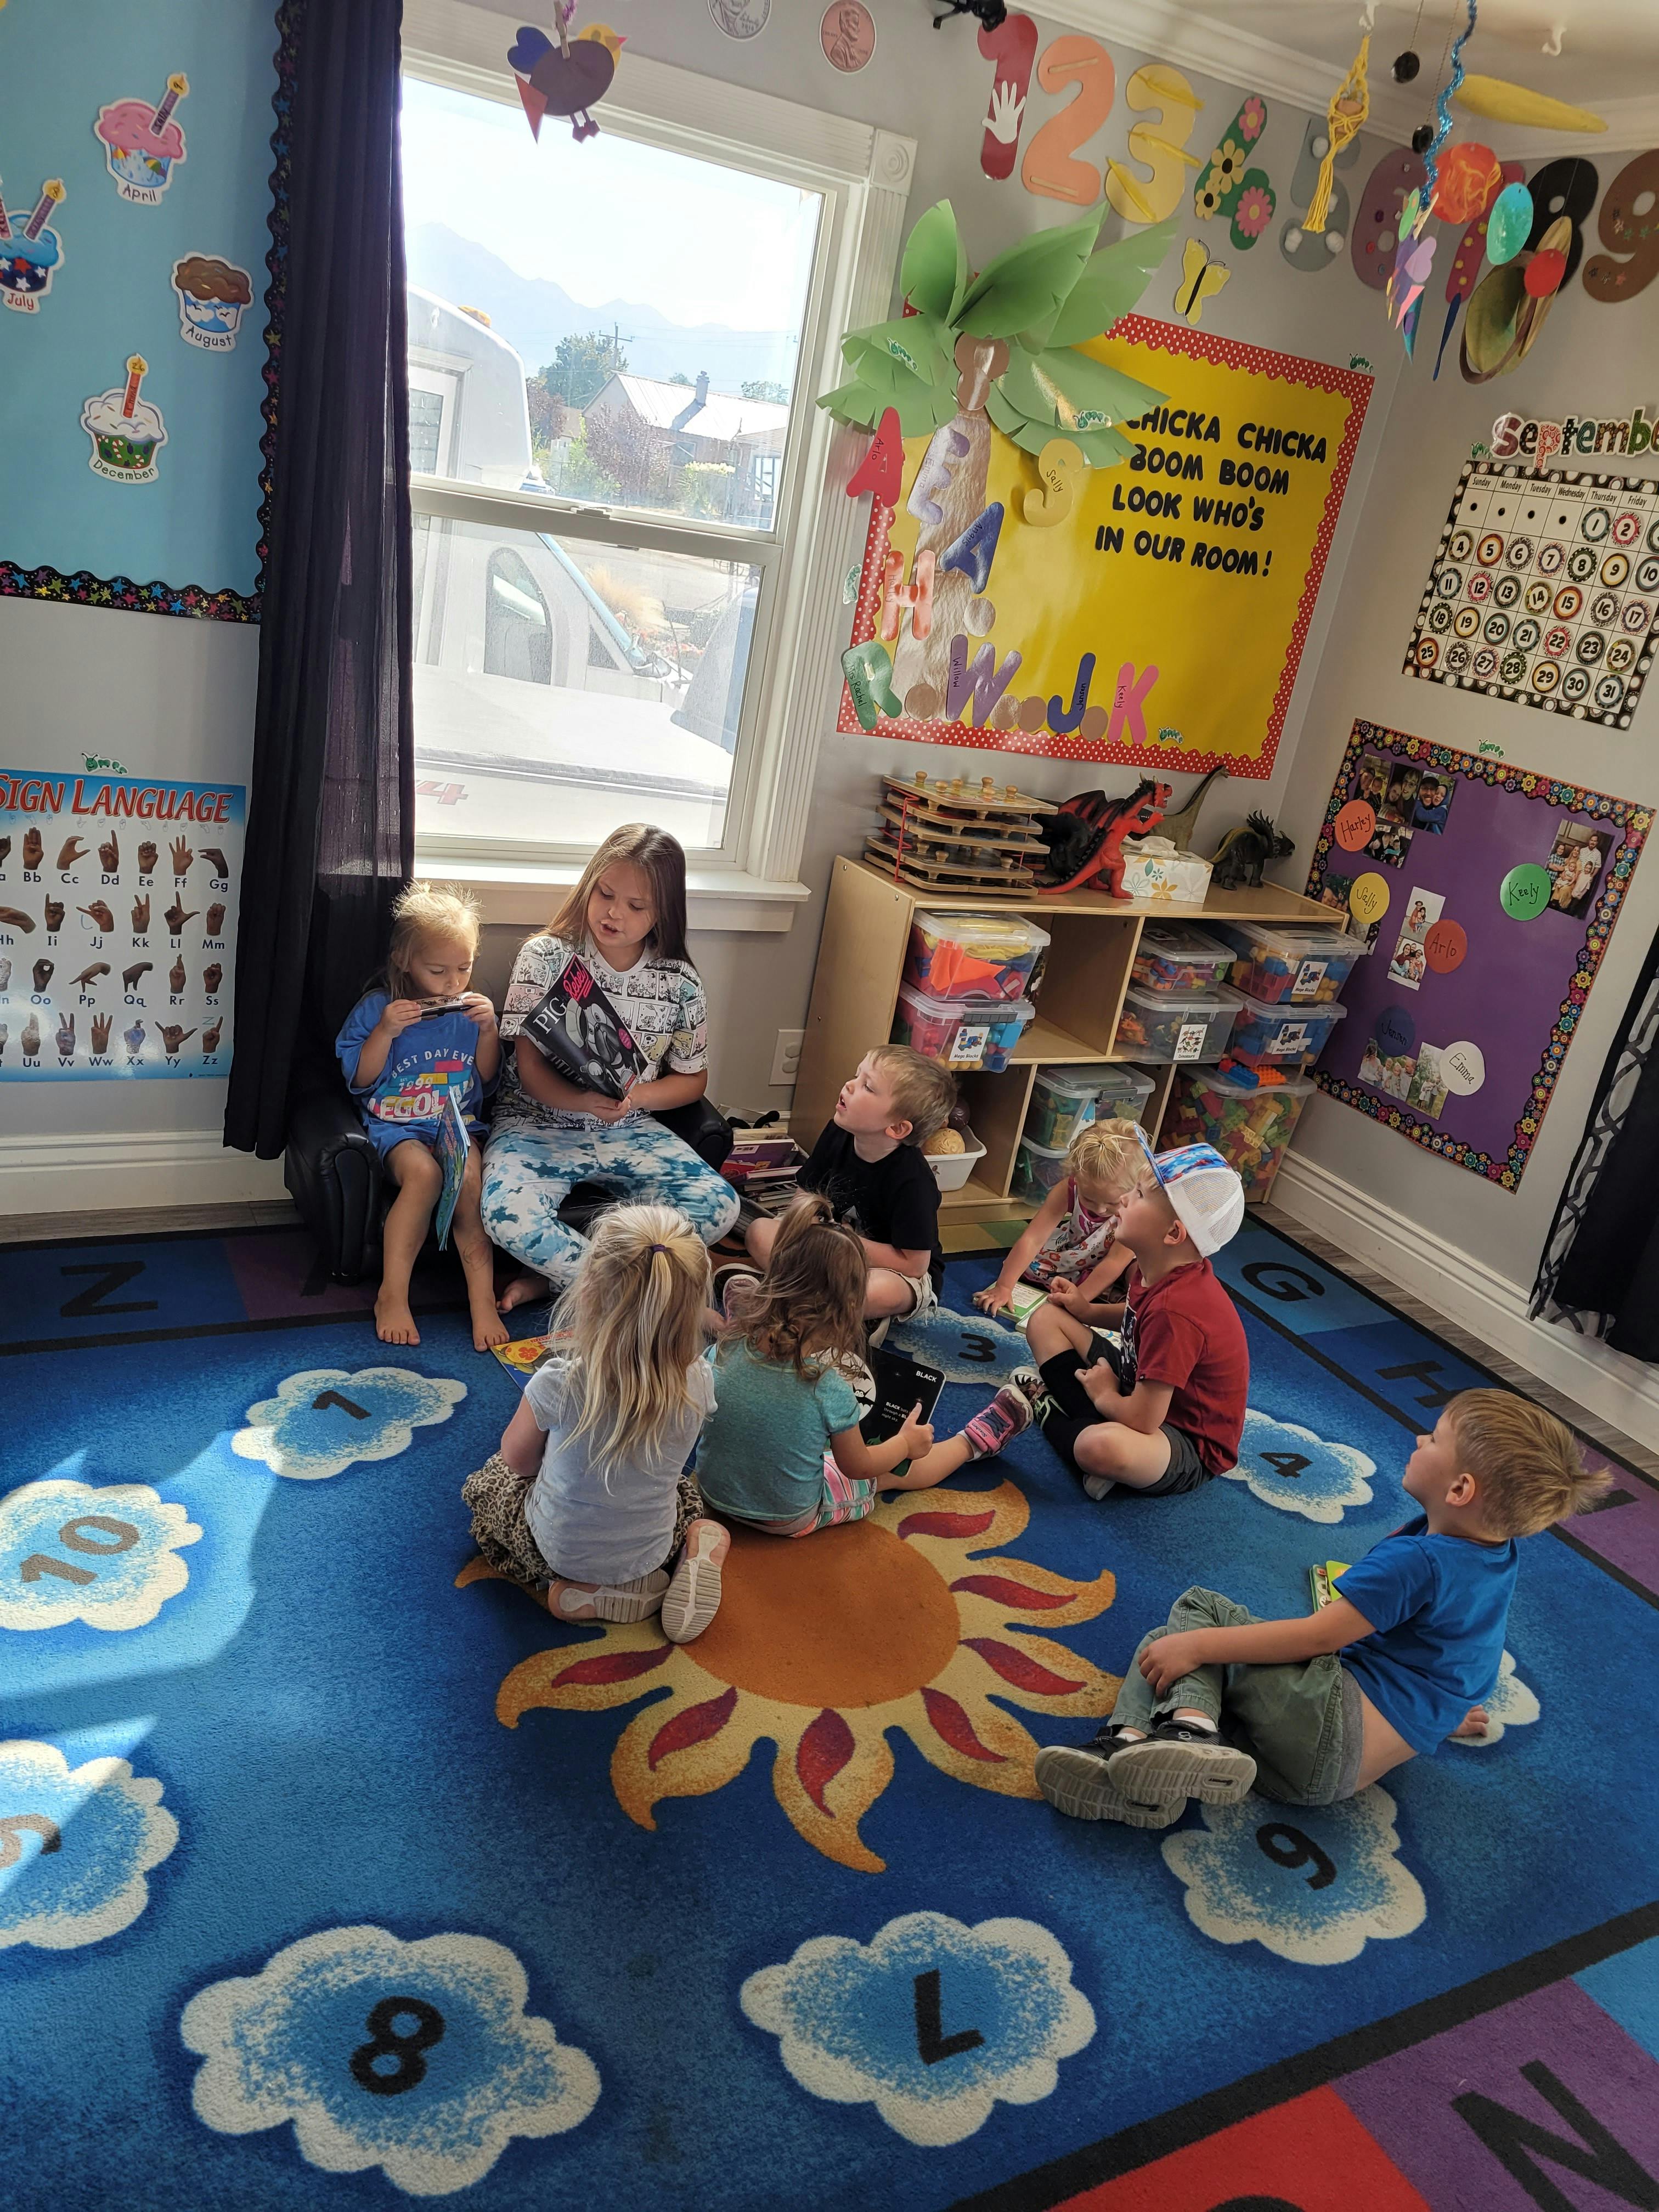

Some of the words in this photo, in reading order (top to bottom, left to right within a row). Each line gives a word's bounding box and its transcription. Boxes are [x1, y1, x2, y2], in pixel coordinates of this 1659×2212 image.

[1022, 35, 1115, 206] 2
[1105, 64, 1197, 224] 3
[1194, 96, 1276, 250] 4
[122, 184, 156, 202] April
[7, 292, 35, 311] July
[185, 326, 233, 348] August
[847, 407, 902, 508] A
[871, 438, 884, 461] Arlo
[1237, 422, 1327, 463] CHICKA
[93, 459, 155, 481] December
[1023, 439, 1084, 527] S
[1046, 470, 1064, 493] Sally
[1130, 443, 1204, 481] BOOM
[1219, 458, 1289, 495] BOOM
[1113, 483, 1182, 520] LOOK
[1193, 496, 1265, 531] WHO'S
[1472, 477, 1491, 488] Sunday
[1500, 481, 1522, 492] Monday
[1530, 483, 1552, 495] Tuesday
[1558, 487, 1586, 500] Wednesday
[1591, 491, 1617, 504] Thursday
[1628, 495, 1647, 508] Friday
[1592, 519, 1600, 532] 1
[1621, 523, 1631, 537] 2
[940, 502, 1005, 594] A
[1094, 525, 1125, 554] IN
[1134, 530, 1185, 563] OUR
[1457, 541, 1464, 553] 4
[1486, 544, 1494, 557] 5
[1515, 548, 1523, 560] 6
[1547, 554, 1555, 566] 7
[1578, 558, 1587, 572] 8
[1610, 564, 1620, 575] 9
[1643, 566, 1658, 582] 10
[881, 550, 936, 641] H
[1444, 579, 1452, 590] 11
[1474, 582, 1486, 594] 12
[1501, 585, 1514, 599] 13
[1532, 590, 1544, 605] 14
[1561, 596, 1575, 610] 15
[1597, 601, 1611, 617] 16
[1628, 610, 1643, 624] 17
[1435, 611, 1446, 625] 18
[1460, 617, 1472, 628] 19
[1488, 622, 1504, 636] 20
[1520, 629, 1533, 642] 21
[1549, 634, 1565, 648] 22
[1582, 641, 1599, 654] 23
[1612, 649, 1629, 663] 24
[946, 634, 1022, 728] W
[952, 656, 962, 687] Willow
[1421, 645, 1434, 660] 25
[1451, 650, 1465, 663] 26
[1477, 656, 1493, 670] 27
[1505, 662, 1521, 675] 28
[1537, 670, 1554, 684] 29
[1567, 678, 1584, 692] 30
[1602, 685, 1617, 698] 31
[850, 680, 867, 707] Rachel
[1047, 652, 1096, 733] J
[1076, 683, 1086, 711] Jensen
[1107, 662, 1159, 744] K
[1114, 685, 1127, 708] Keely
[71, 778, 233, 823] LANGUAGE
[1340, 814, 1372, 842] Harley
[24, 872, 41, 883] Bb
[61, 873, 79, 884] Cc
[101, 874, 119, 885] Dd
[139, 876, 154, 887] Ee
[174, 878, 187, 888] Ff
[210, 879, 228, 893] Gg
[1509, 882, 1539, 906] Keely
[1357, 887, 1378, 915] Sally
[48, 935, 58, 946] Ii
[90, 936, 103, 949] Jj
[132, 937, 149, 947] Kk
[171, 938, 180, 948] Ll
[202, 939, 225, 949] Mm
[1429, 933, 1457, 958] Arlo
[31, 994, 51, 1005] Oo
[79, 995, 95, 1008] Pp
[124, 995, 147, 1007] Qq
[170, 996, 184, 1005] Rr
[206, 996, 219, 1005] Ss
[532, 997, 567, 1035] PIG
[562, 963, 592, 1000] Rebel
[23, 1057, 40, 1067] Uu
[58, 1057, 75, 1066] Vv
[89, 1057, 114, 1066] Ww
[126, 1056, 144, 1065] Xx
[165, 1056, 181, 1068] Yy
[202, 1055, 218, 1064] Zz
[392, 1054, 417, 1079] BEST
[425, 1048, 449, 1060] DAY
[1449, 1052, 1475, 1084] Emma
[398, 1076, 433, 1092] 1999
[1242, 1262, 1325, 1302] G
[916, 1370, 938, 1383] BLACK
[312, 1390, 372, 1420] 1
[884, 1407, 898, 1415] through
[885, 1402, 901, 1410] BLACK
[1259, 1452, 1314, 1478] 4
[20, 1515, 140, 1586] 10
[348, 1996, 447, 2096] 8
